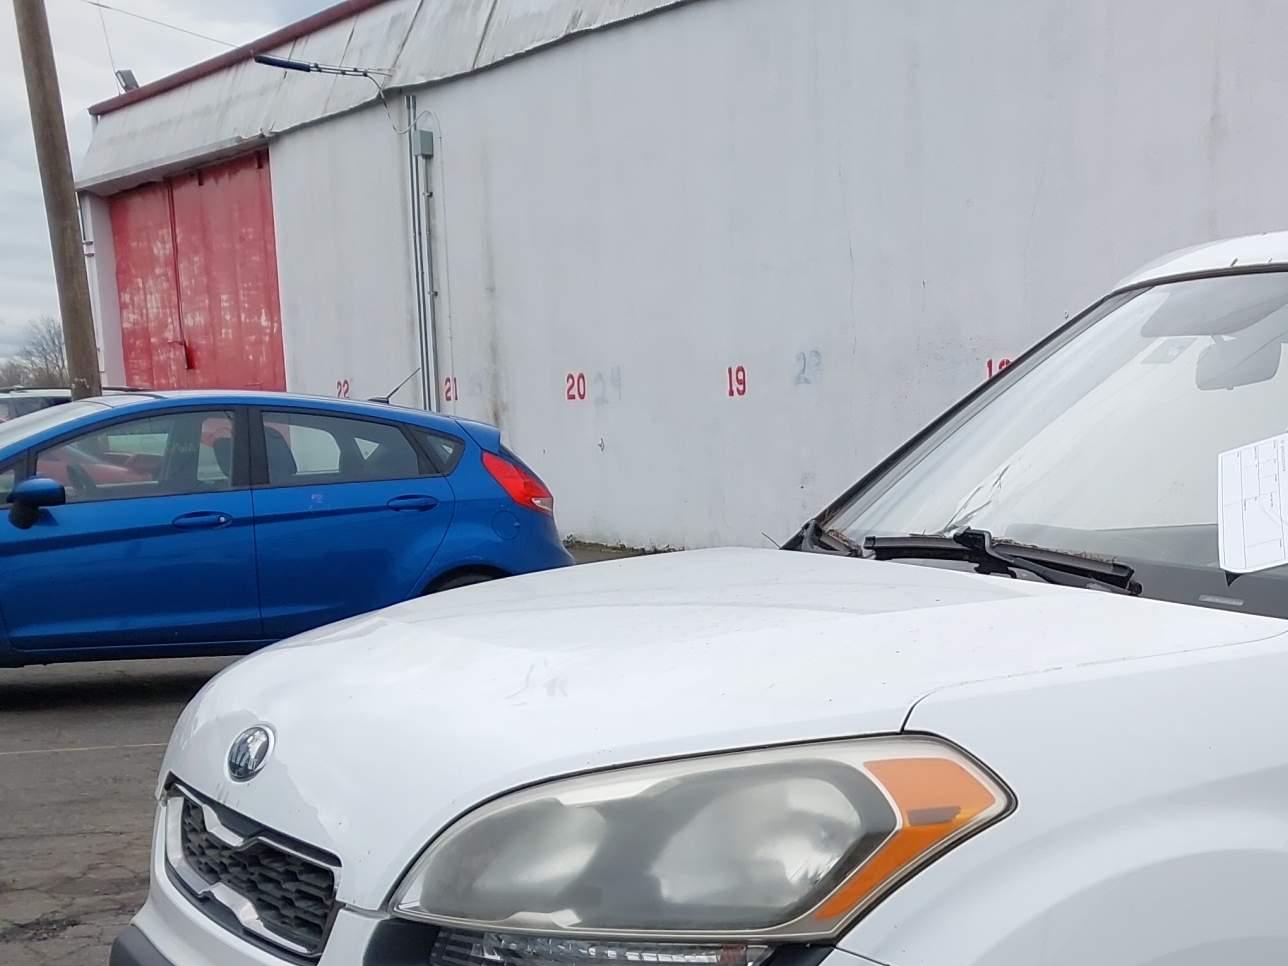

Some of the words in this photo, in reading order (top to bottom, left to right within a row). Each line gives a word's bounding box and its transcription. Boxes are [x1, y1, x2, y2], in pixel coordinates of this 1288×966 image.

[336, 379, 351, 399] 22
[444, 377, 459, 401] 21
[566, 373, 586, 401] 20
[727, 365, 747, 397] 19
